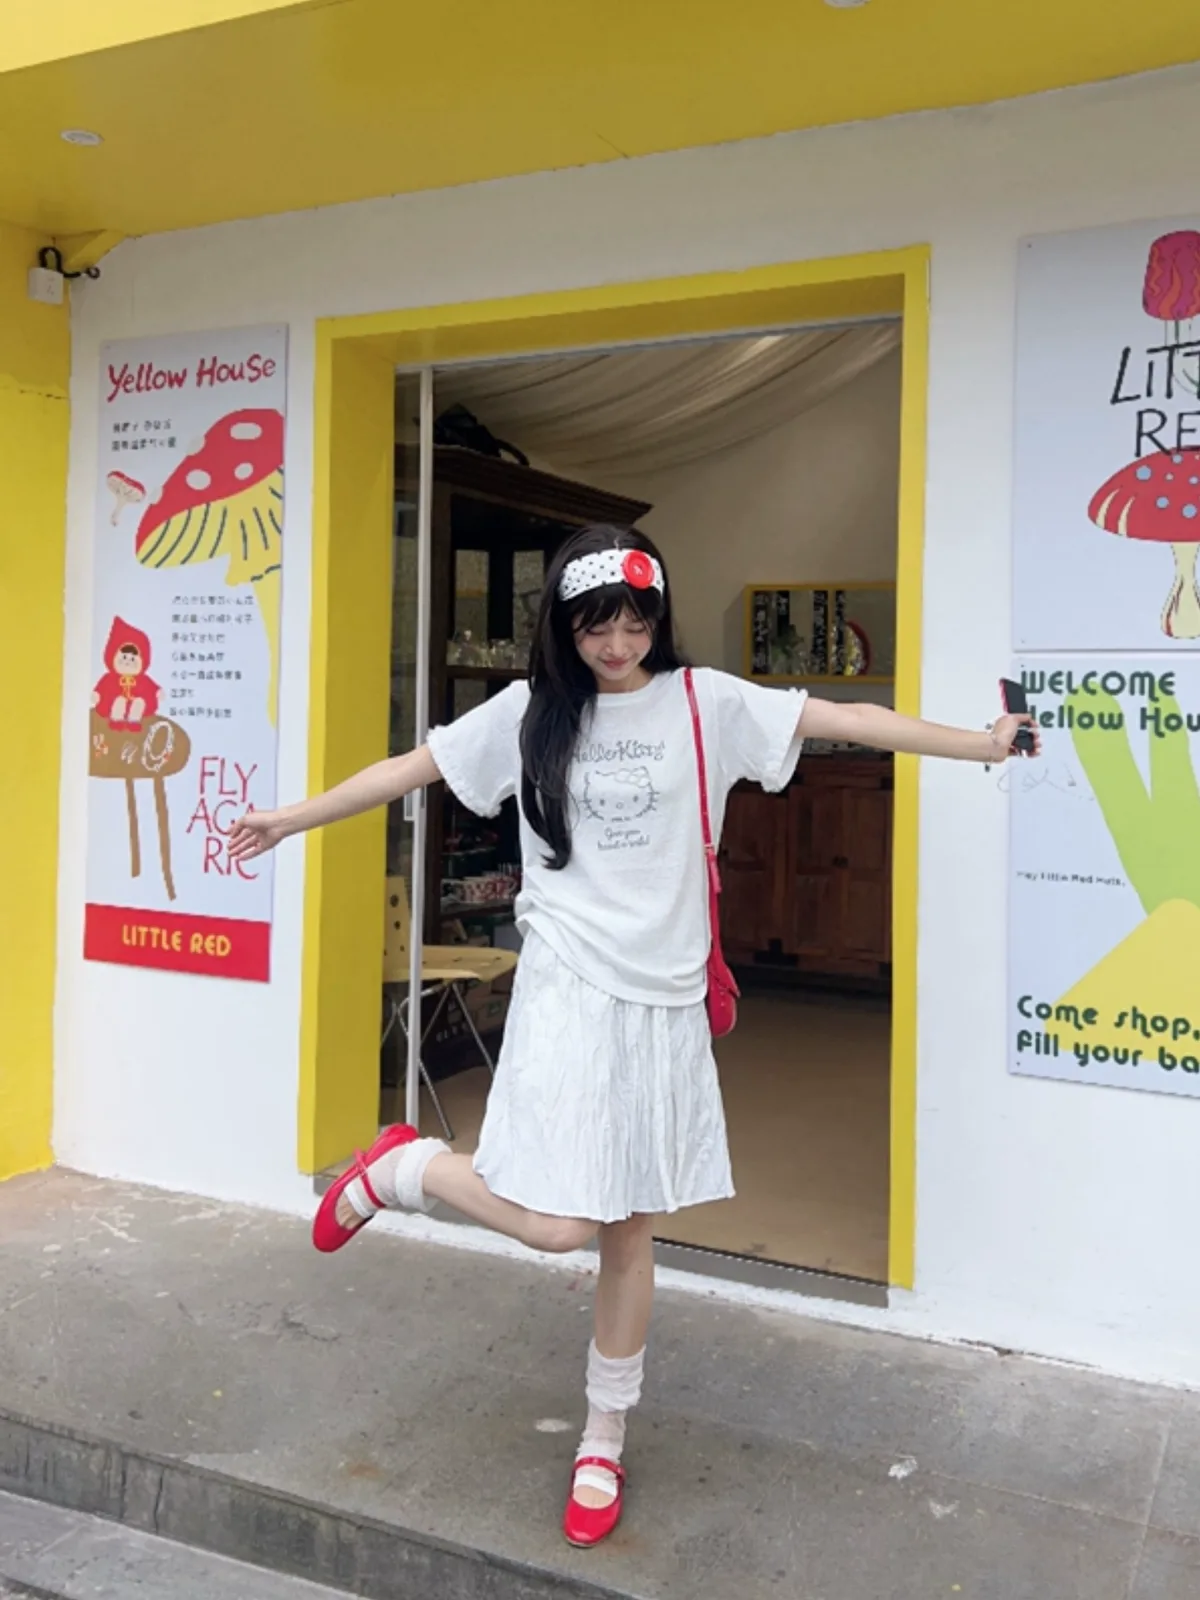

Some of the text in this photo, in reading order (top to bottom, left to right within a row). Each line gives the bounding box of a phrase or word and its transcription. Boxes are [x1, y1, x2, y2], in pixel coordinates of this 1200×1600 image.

[107, 362, 188, 403] Yellow
[1020, 670, 1176, 702] WELCOME
[1139, 706, 1200, 739] Hou
[200, 756, 258, 802] FLY
[187, 797, 257, 837] AG
[122, 924, 232, 957] LITTLE RED
[1017, 995, 1099, 1031] Come
[1073, 1041, 1143, 1067] your
